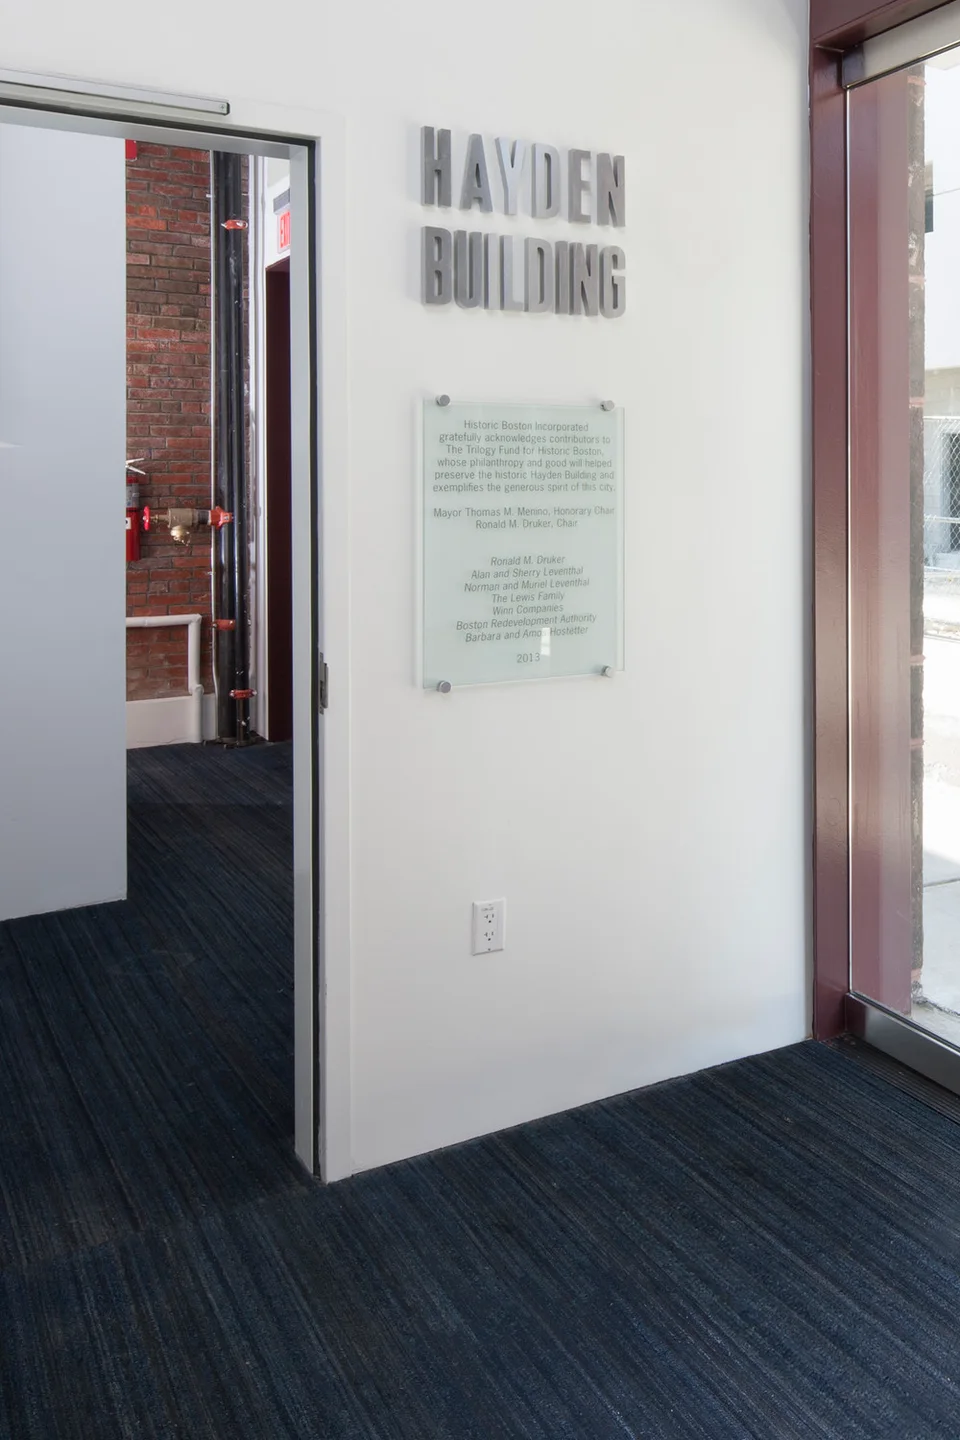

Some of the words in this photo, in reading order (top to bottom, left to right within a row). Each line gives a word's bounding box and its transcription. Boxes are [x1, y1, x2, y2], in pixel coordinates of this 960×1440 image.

[420, 125, 626, 228] HAYDEN
[420, 225, 626, 319] BUILDING
[464, 419, 499, 430] Historic
[502, 421, 532, 430] Boston
[535, 421, 589, 432] Incorporated
[439, 433, 481, 443] gratefully
[485, 433, 546, 445] acknowledges
[550, 435, 600, 444] contributors
[602, 436, 610, 444] to
[446, 444, 463, 455] The
[467, 445, 496, 456] Trilogy
[499, 445, 520, 455] Fund
[523, 446, 534, 455] for
[538, 446, 570, 455] Historic
[437, 459, 467, 467] whose
[470, 458, 524, 469] philanthropy
[527, 458, 542, 468] and
[545, 458, 566, 470] good
[569, 459, 582, 468] will
[585, 459, 612, 469] helped
[434, 471, 475, 481] preserve
[479, 470, 492, 479] the
[495, 470, 527, 480] historic
[530, 471, 562, 481] Hayden
[565, 471, 596, 481] Building
[600, 471, 614, 480] and
[487, 483, 501, 492] the
[504, 485, 544, 494] generous
[548, 482, 568, 493] spirit
[571, 482, 579, 491] of
[582, 482, 596, 491] this
[599, 482, 616, 492] city.
[433, 508, 462, 520] Mayor
[465, 507, 501, 517] Thomas
[504, 507, 514, 517] M.
[554, 506, 591, 517] Honorary
[594, 506, 614, 515] Chair
[475, 520, 506, 529] Ronald
[509, 519, 519, 529] M.
[557, 519, 578, 528] Chair
[490, 556, 520, 566] Ronald
[523, 556, 534, 565] M.
[537, 555, 565, 565] Druker
[471, 570, 490, 579] Alan
[493, 569, 509, 578] and
[512, 568, 540, 578] Sherry
[543, 566, 583, 576] Leventhal
[464, 582, 499, 592] Norman
[502, 581, 518, 590] and
[521, 580, 547, 589] Muriel
[550, 578, 590, 588] Leventhal
[492, 594, 508, 603] The
[510, 593, 535, 602] Lewis
[538, 591, 565, 602] Family
[492, 606, 513, 616] Winn
[516, 603, 563, 615] Companies
[456, 620, 488, 631] Boston
[491, 617, 557, 629] Redevelopment
[560, 613, 596, 624] Authority
[465, 632, 501, 642] Barbara
[504, 630, 520, 639] and
[516, 653, 540, 664] 2013
